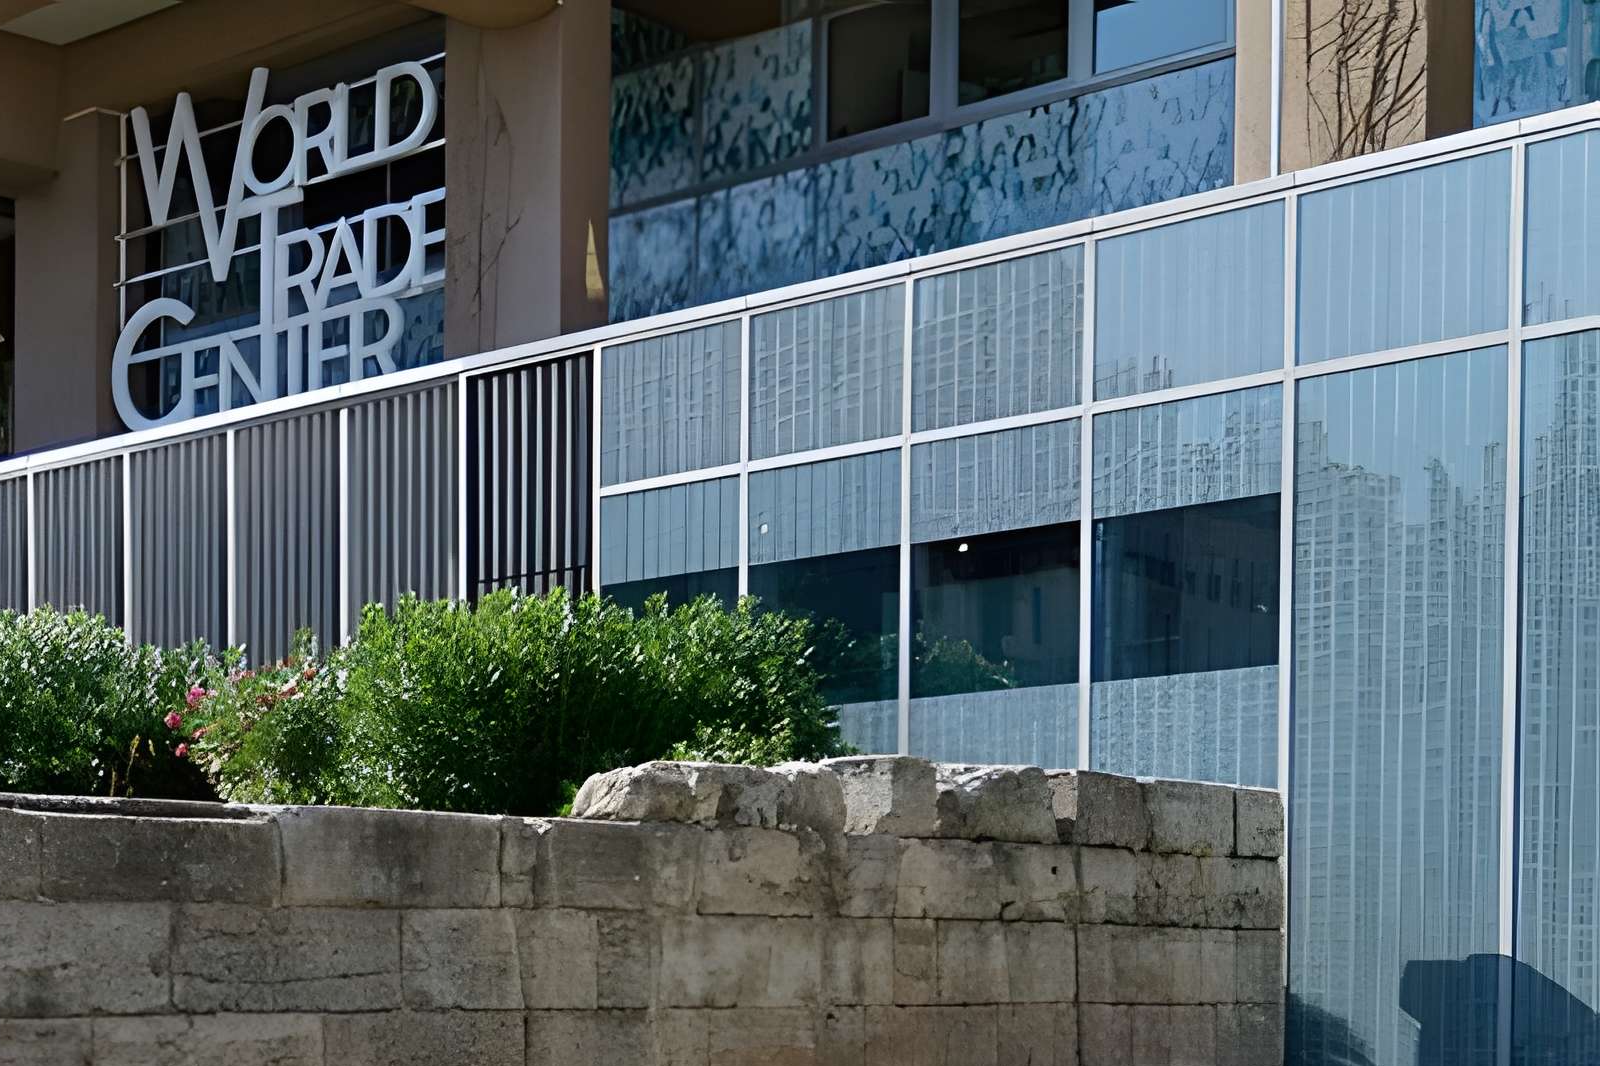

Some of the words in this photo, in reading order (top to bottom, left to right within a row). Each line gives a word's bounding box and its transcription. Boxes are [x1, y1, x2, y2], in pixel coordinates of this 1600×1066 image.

[131, 66, 438, 282] WORLD
[234, 187, 446, 334] TRADE
[112, 298, 405, 432] CENTER
